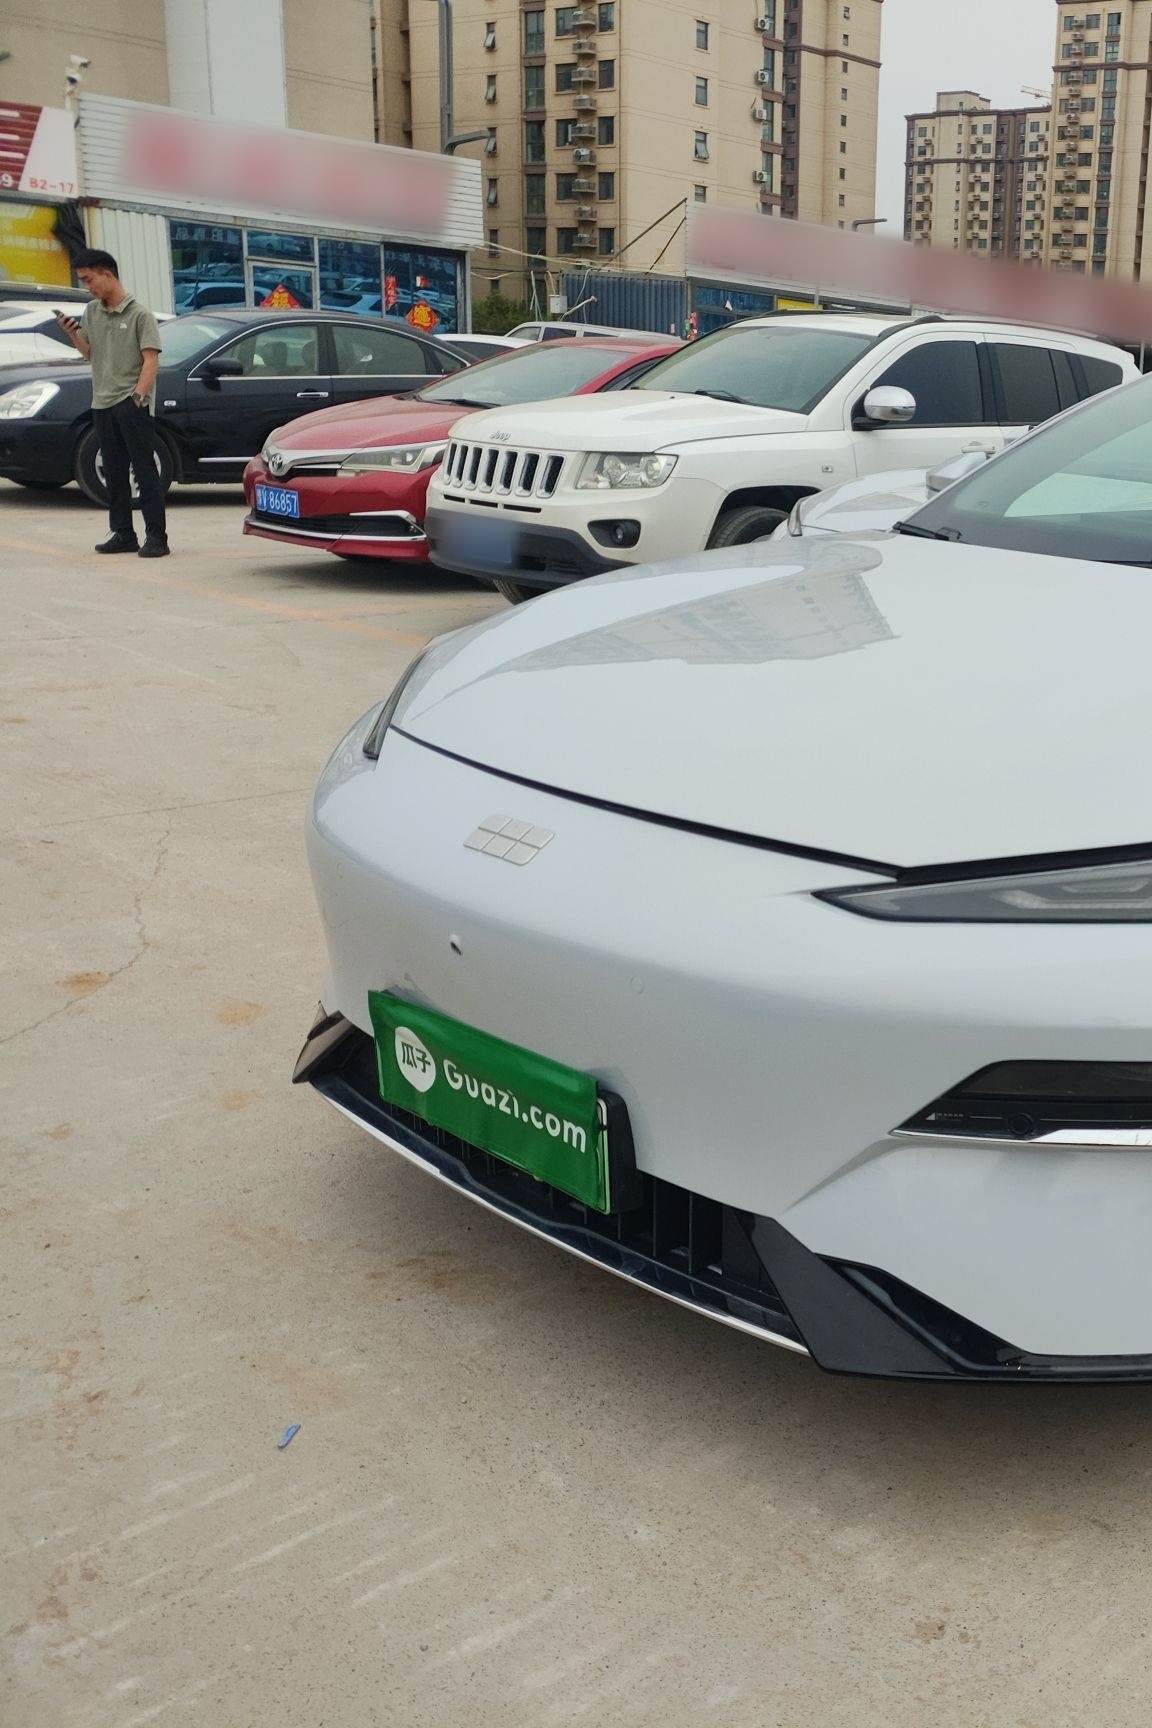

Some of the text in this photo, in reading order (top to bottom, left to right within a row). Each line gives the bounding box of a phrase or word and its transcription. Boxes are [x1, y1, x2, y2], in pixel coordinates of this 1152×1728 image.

[29, 176, 74, 194] B2-17
[401, 1041, 431, 1074] 瓜子
[443, 1059, 587, 1154] Guazi.com
